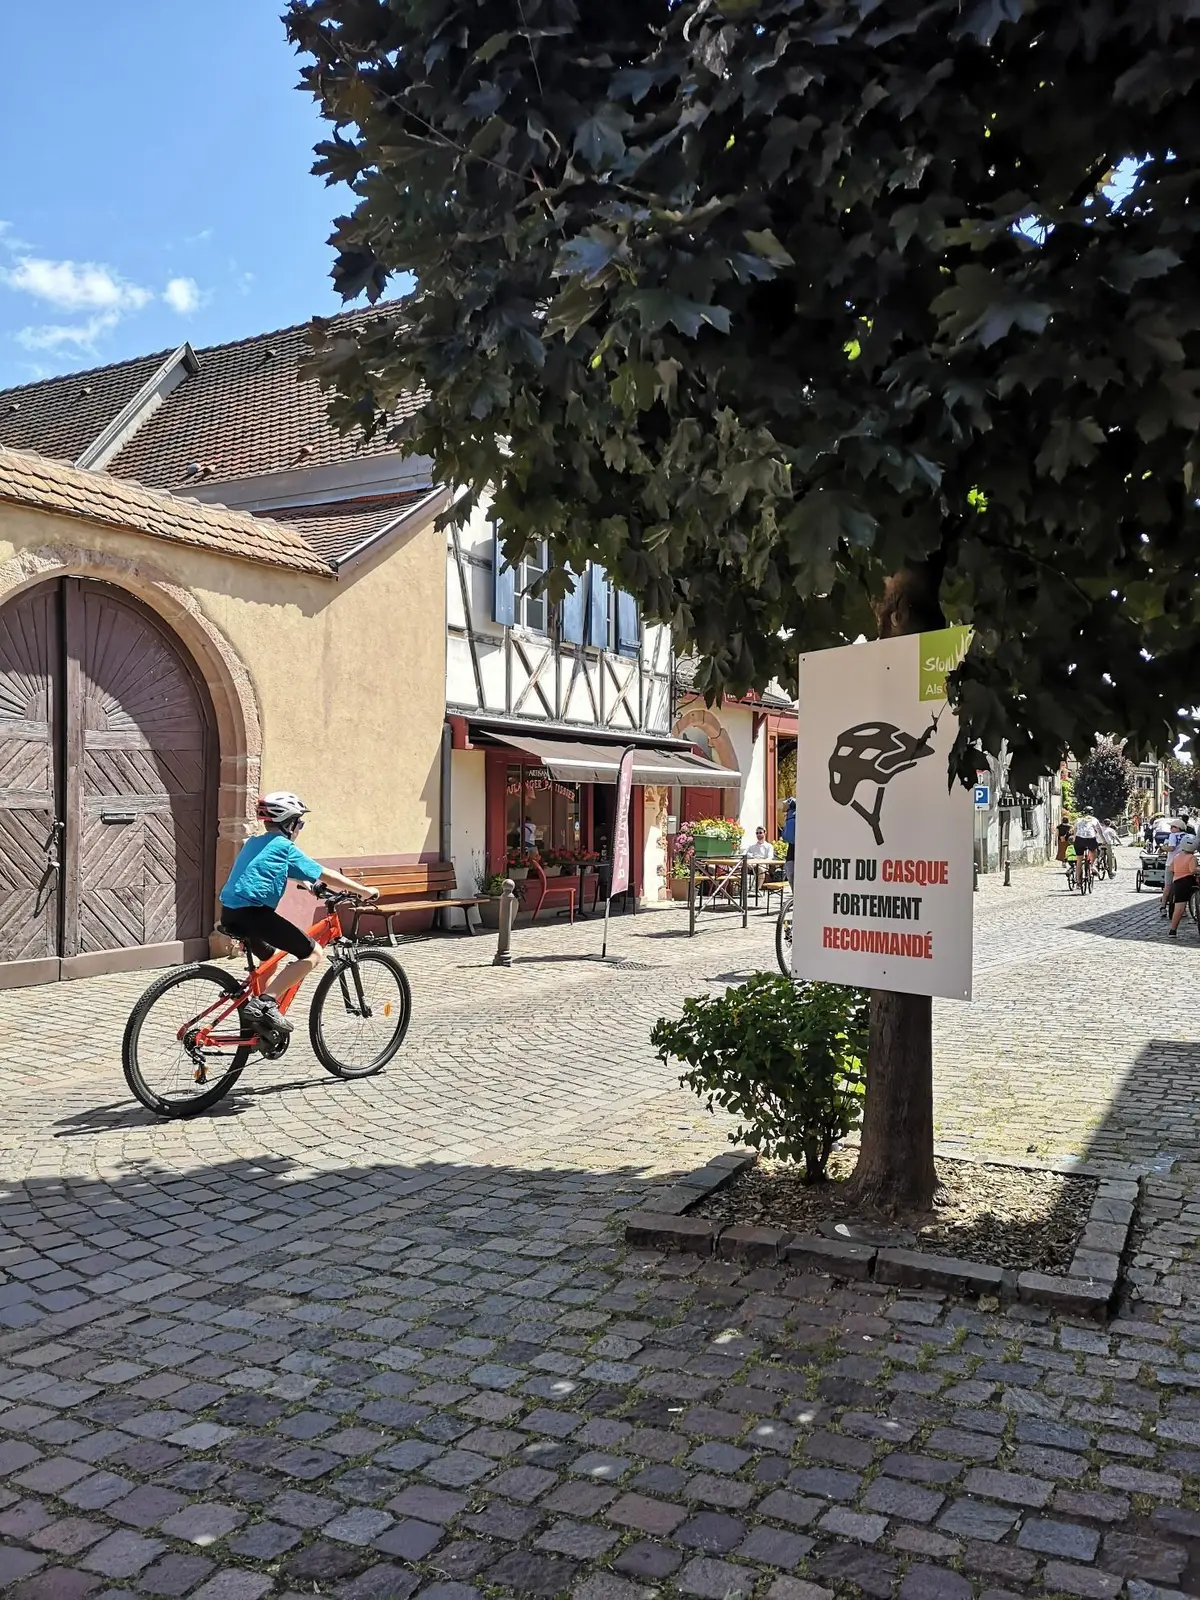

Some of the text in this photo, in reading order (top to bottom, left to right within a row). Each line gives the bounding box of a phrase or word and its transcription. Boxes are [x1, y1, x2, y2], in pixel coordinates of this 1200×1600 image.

[925, 683, 947, 695] Als
[975, 790, 984, 802] P
[813, 858, 949, 886] PORT DU CASQUE
[833, 893, 922, 920] FORTEMENT
[823, 926, 933, 959] RECOMMANDÉ
